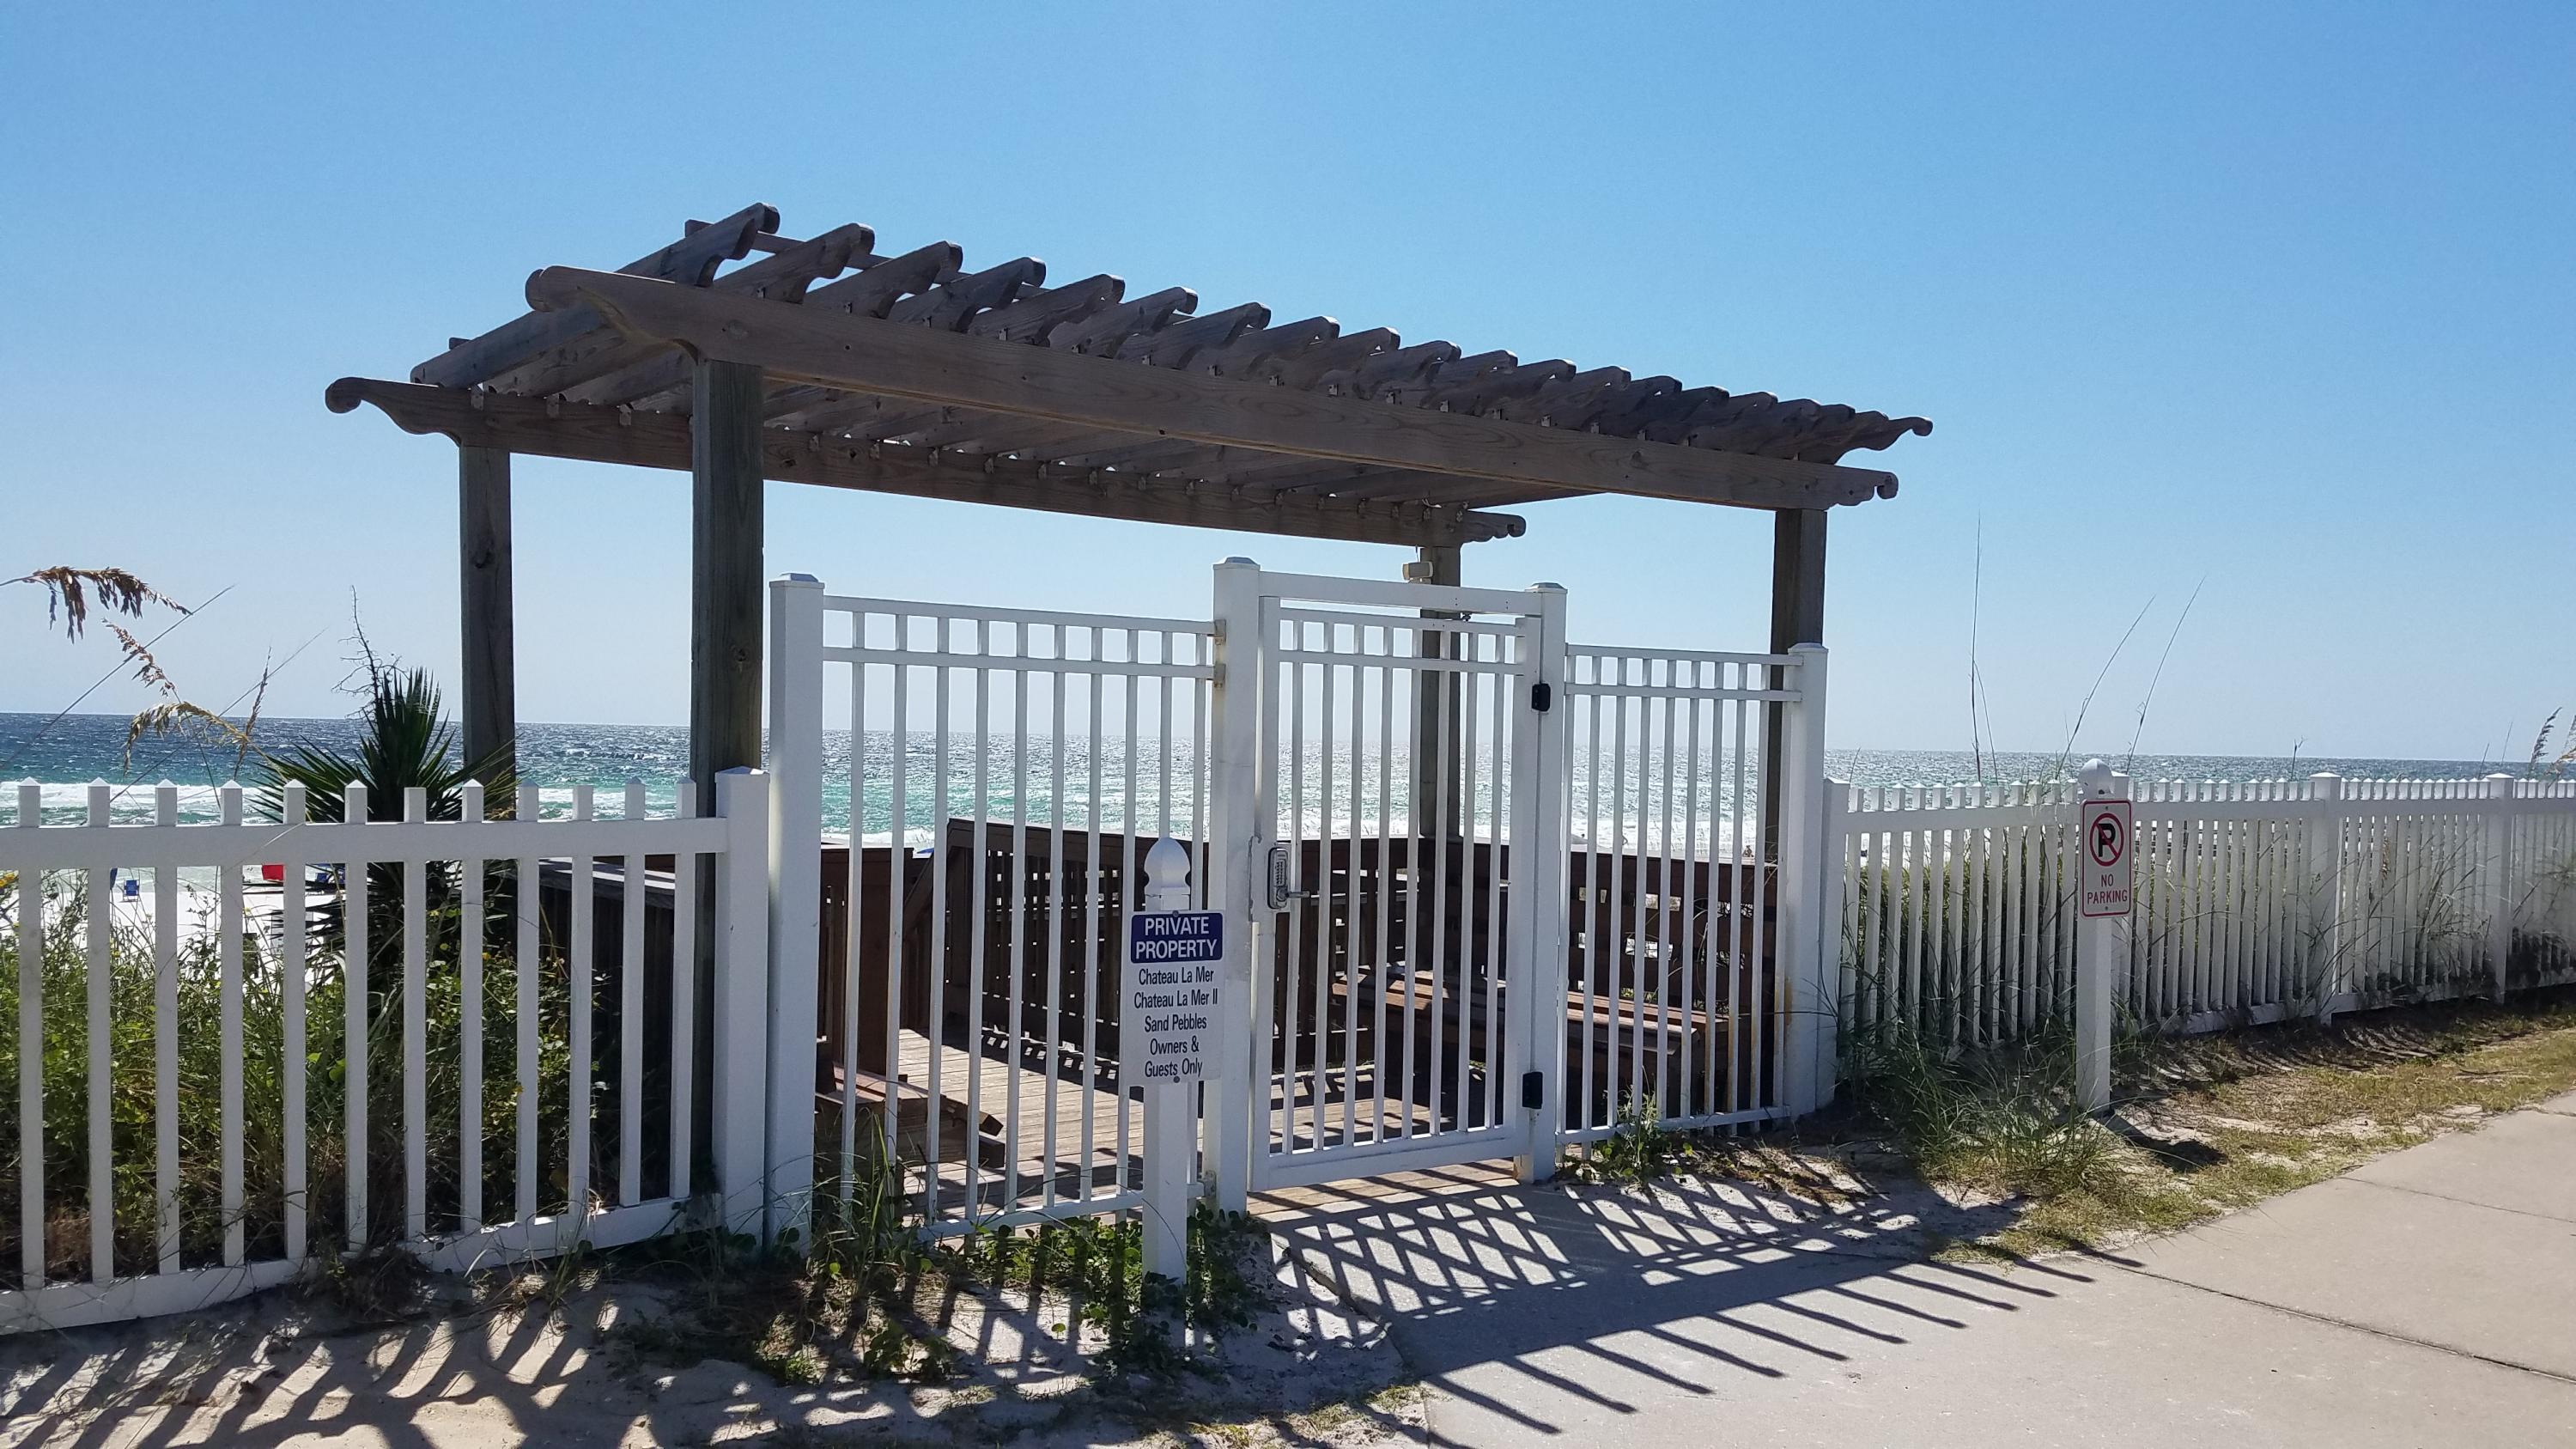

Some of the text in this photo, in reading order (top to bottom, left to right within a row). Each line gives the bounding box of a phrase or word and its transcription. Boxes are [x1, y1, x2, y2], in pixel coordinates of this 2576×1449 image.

[2099, 823, 2116, 857] P
[2101, 874, 2114, 886] NO
[2087, 889, 2128, 904] PARKING
[1145, 916, 1209, 935] PRIVATE
[1135, 939, 1218, 959] PROPERTY
[1139, 965, 1214, 985] Chateau La Mer
[1134, 988, 1218, 1008] Chateau La Mer II
[1145, 1013, 1207, 1032] Sand Pebbles
[1150, 1035, 1199, 1056] Owners &
[1145, 1057, 1202, 1078] Guests Only
